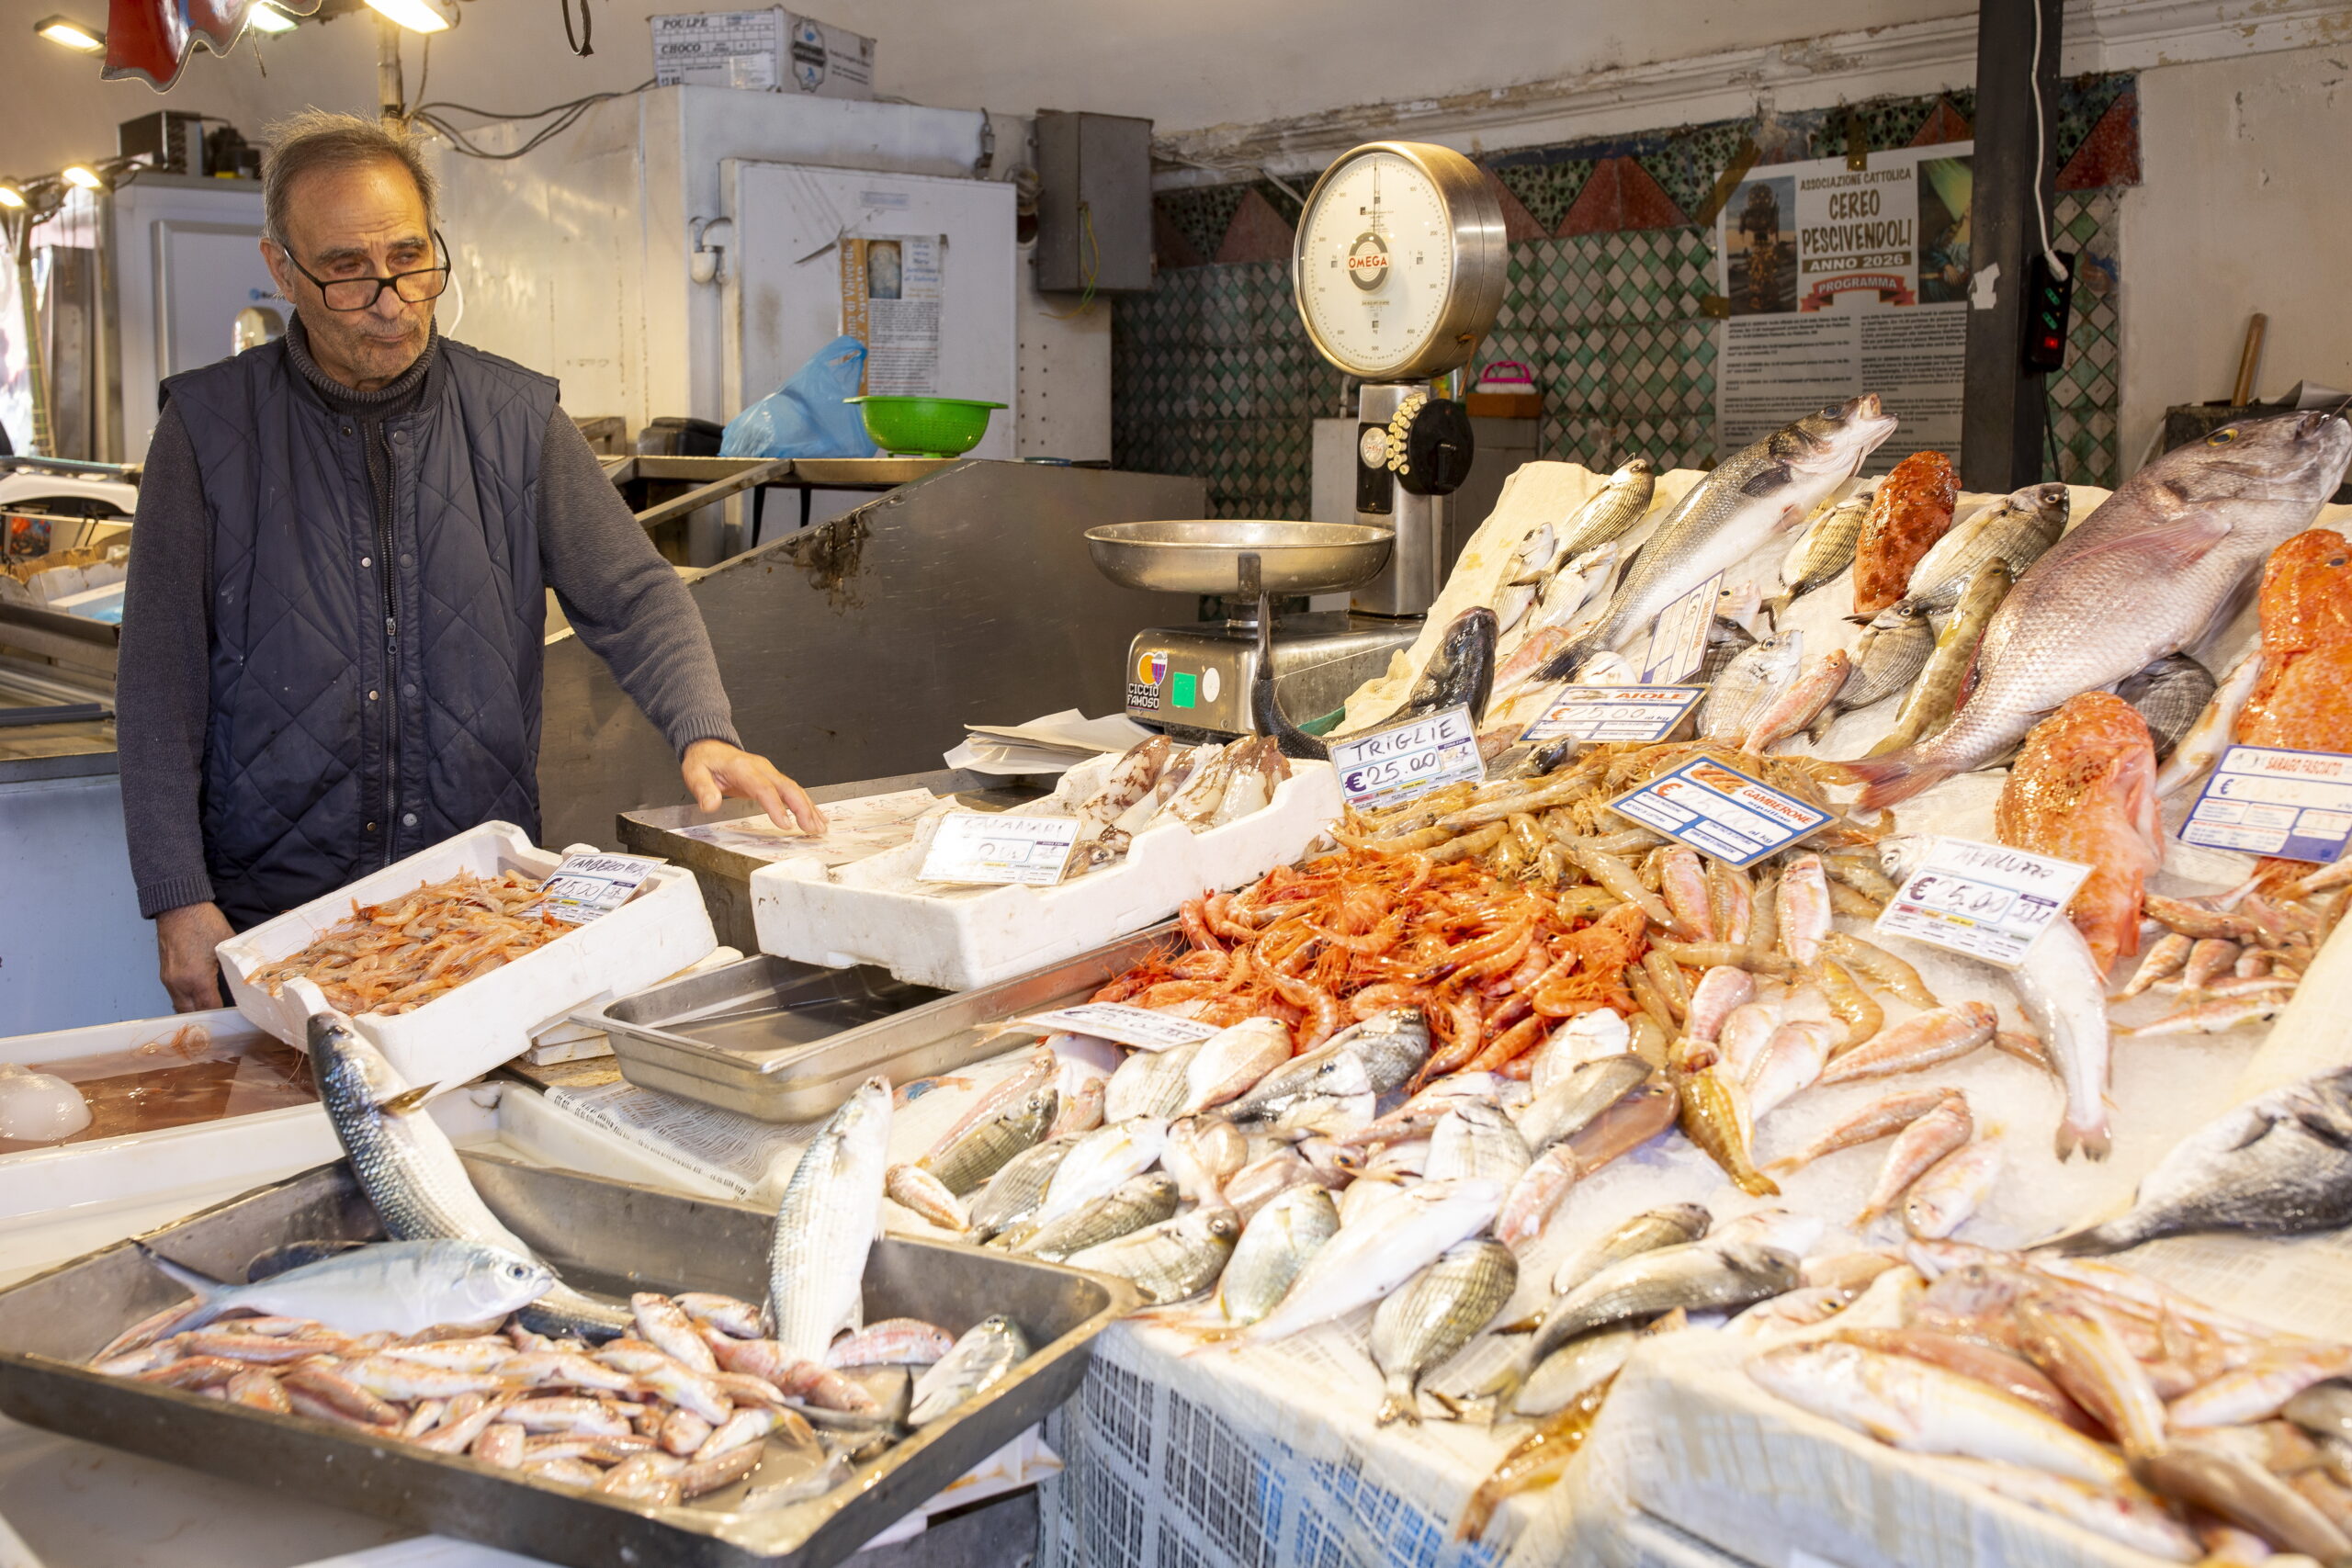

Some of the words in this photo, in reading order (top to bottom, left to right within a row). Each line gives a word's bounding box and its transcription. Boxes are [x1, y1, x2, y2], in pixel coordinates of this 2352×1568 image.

[662, 17, 708, 29] POULPE
[661, 42, 702, 54] CHOCO
[1800, 174, 1861, 191] ASSOCIAZIONE
[1863, 169, 1912, 184] CATTOLICA
[1828, 188, 1881, 220] CEREO
[1802, 219, 1912, 255] PESCIVENDOLI
[1349, 256, 1388, 269] OMEGA
[1809, 256, 1859, 272] ANNO
[1862, 254, 1905, 267] 2026
[1818, 276, 1898, 294] PROGRAMMA
[1128, 682, 1159, 697] CICCIO
[1613, 692, 1687, 700] AIOLE
[1127, 694, 1159, 709] FAMOSO
[1350, 717, 1456, 761] TRIGLIE
[1742, 788, 1815, 825] GAMBERONE
